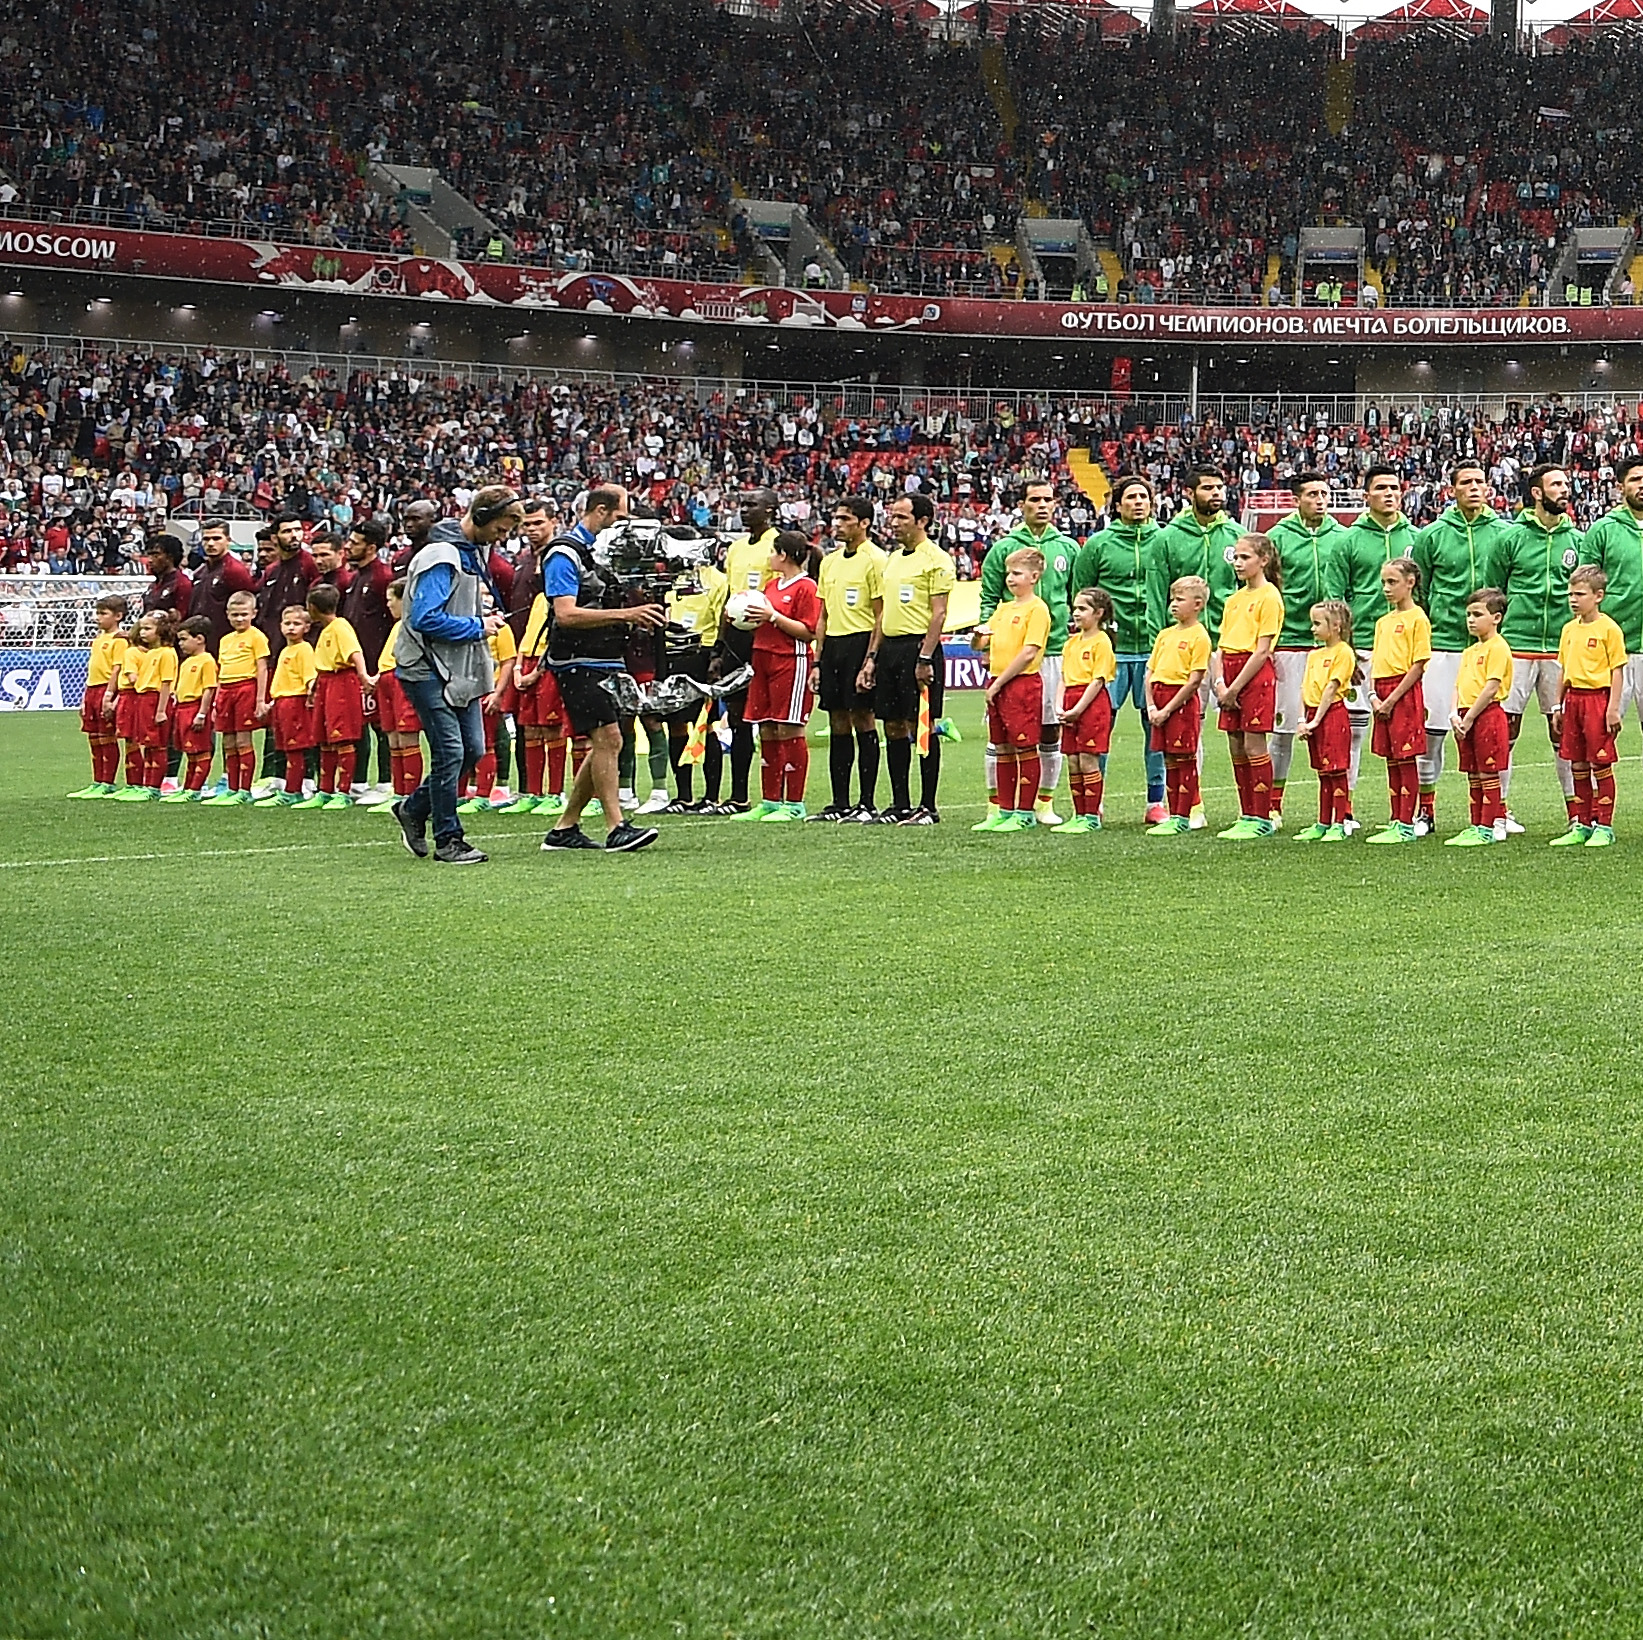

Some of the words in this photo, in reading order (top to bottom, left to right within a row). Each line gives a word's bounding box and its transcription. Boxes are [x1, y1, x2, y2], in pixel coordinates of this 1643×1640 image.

[1061, 311, 1155, 331] ФУТБОЛ
[1160, 314, 1309, 334] ЧЕМПИОНОВ.
[1312, 316, 1389, 334] МЕЧТА
[1394, 316, 1572, 337] БОЛЕЛЬЩИКОВ.
[0, 668, 64, 711] SA
[361, 693, 376, 711] 16
